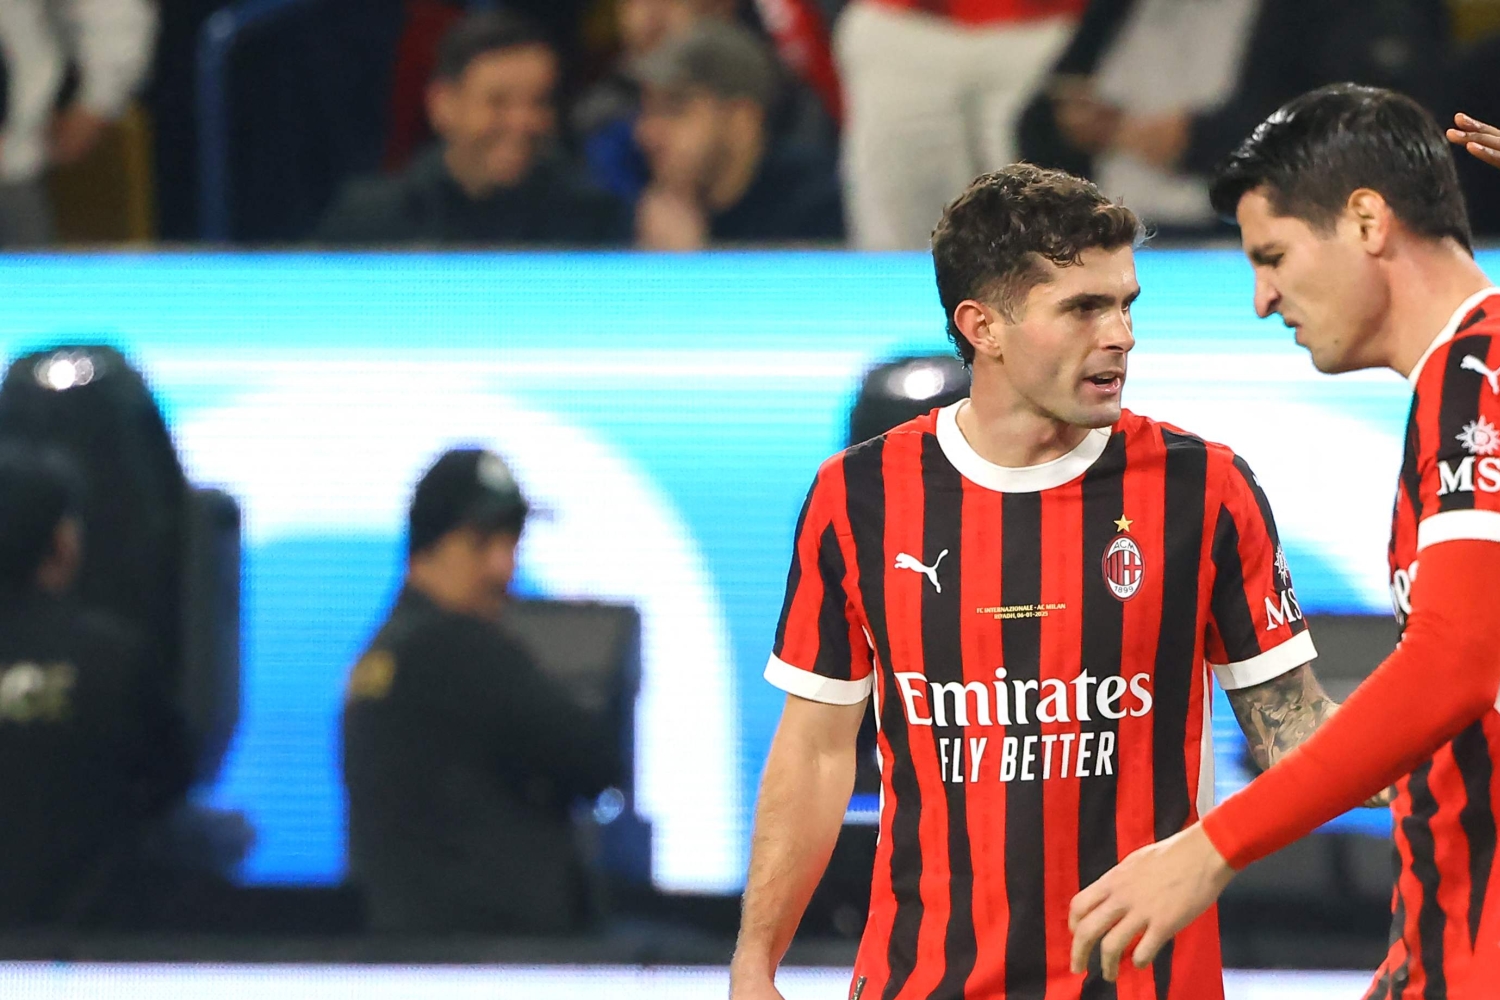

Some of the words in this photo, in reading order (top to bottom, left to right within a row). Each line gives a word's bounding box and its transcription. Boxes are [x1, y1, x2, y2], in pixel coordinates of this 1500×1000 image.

[1113, 540, 1135, 552] ACM
[1264, 587, 1302, 631] MS
[894, 667, 1153, 727] Emirates
[939, 737, 988, 783] FLY
[999, 731, 1115, 782] BETTER
